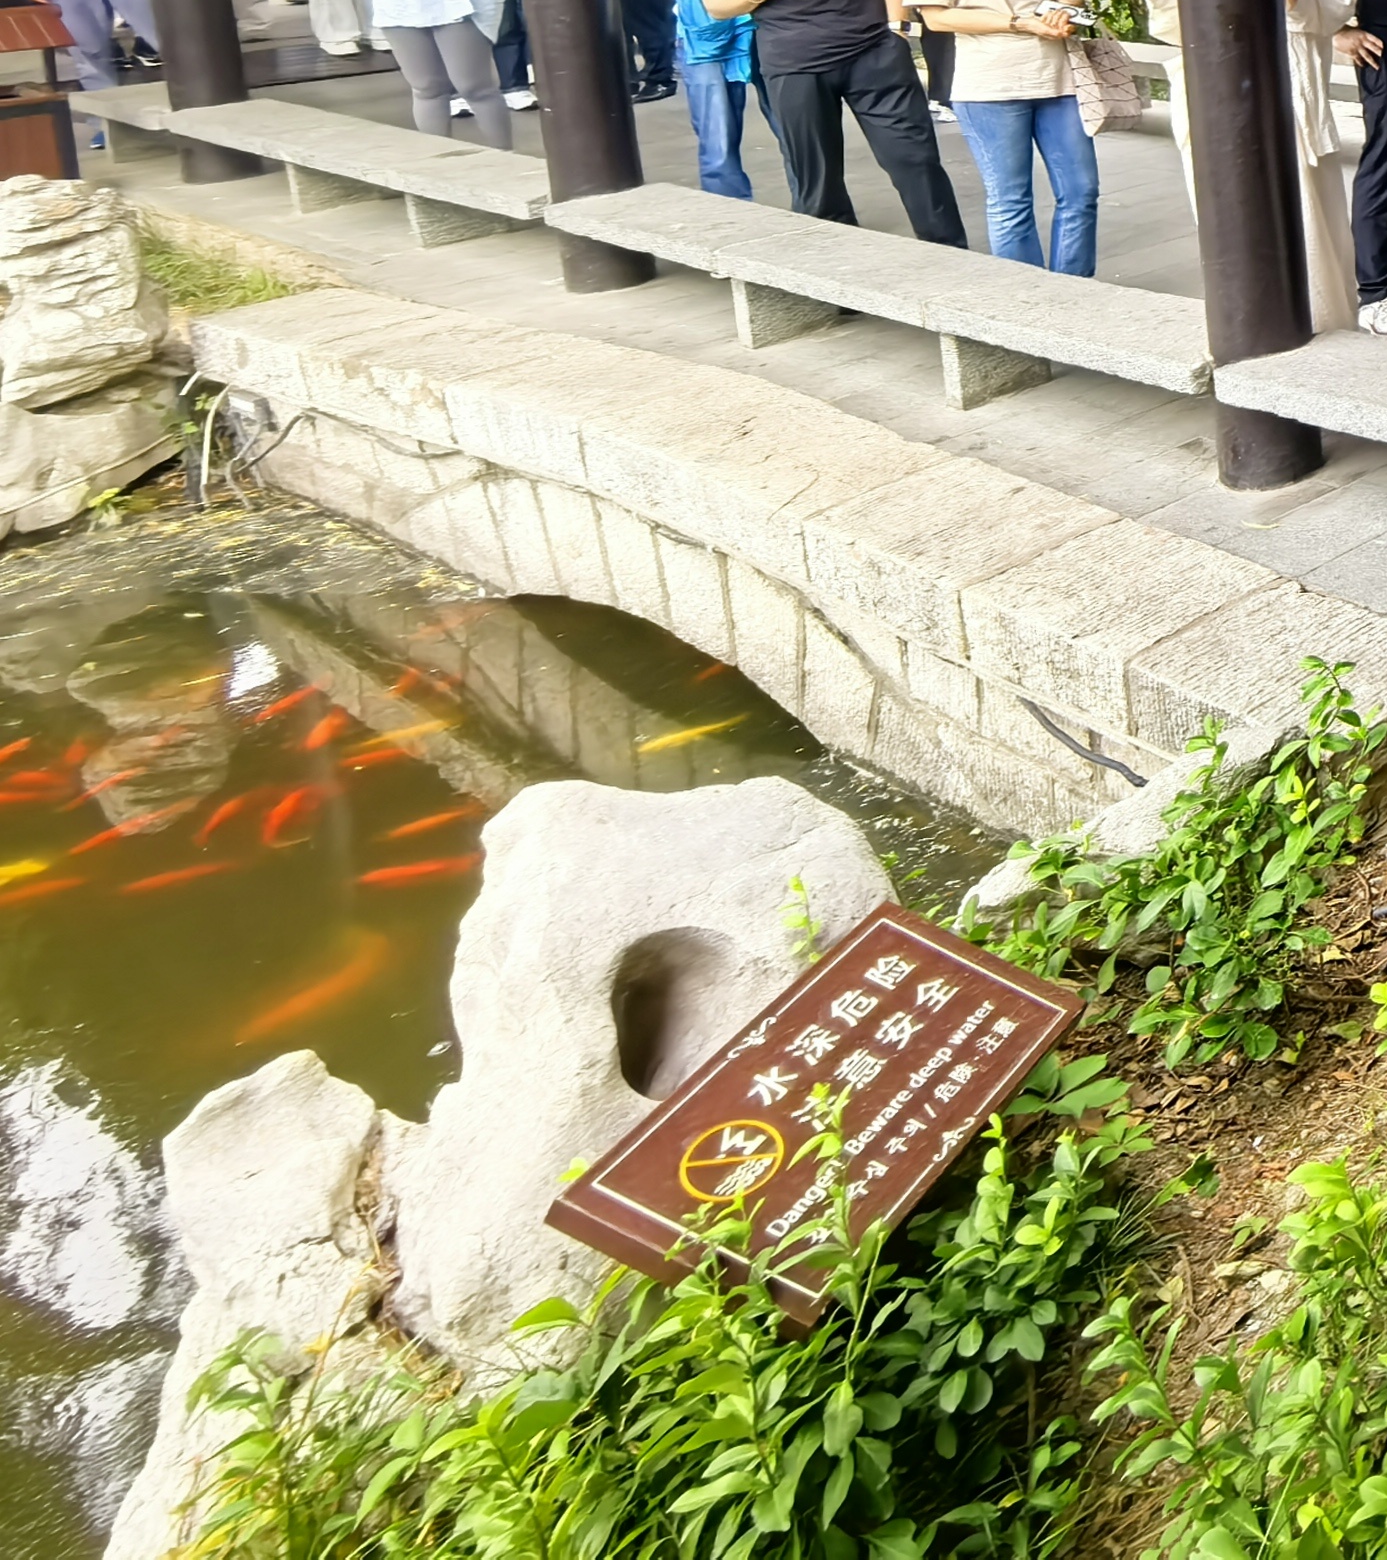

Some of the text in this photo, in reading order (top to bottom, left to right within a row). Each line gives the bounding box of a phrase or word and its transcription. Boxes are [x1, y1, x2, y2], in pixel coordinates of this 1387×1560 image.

[747, 954, 916, 1107] 水深危险
[843, 1085, 914, 1156] Beware
[909, 1046, 954, 1089] deep
[948, 1000, 996, 1046] water
